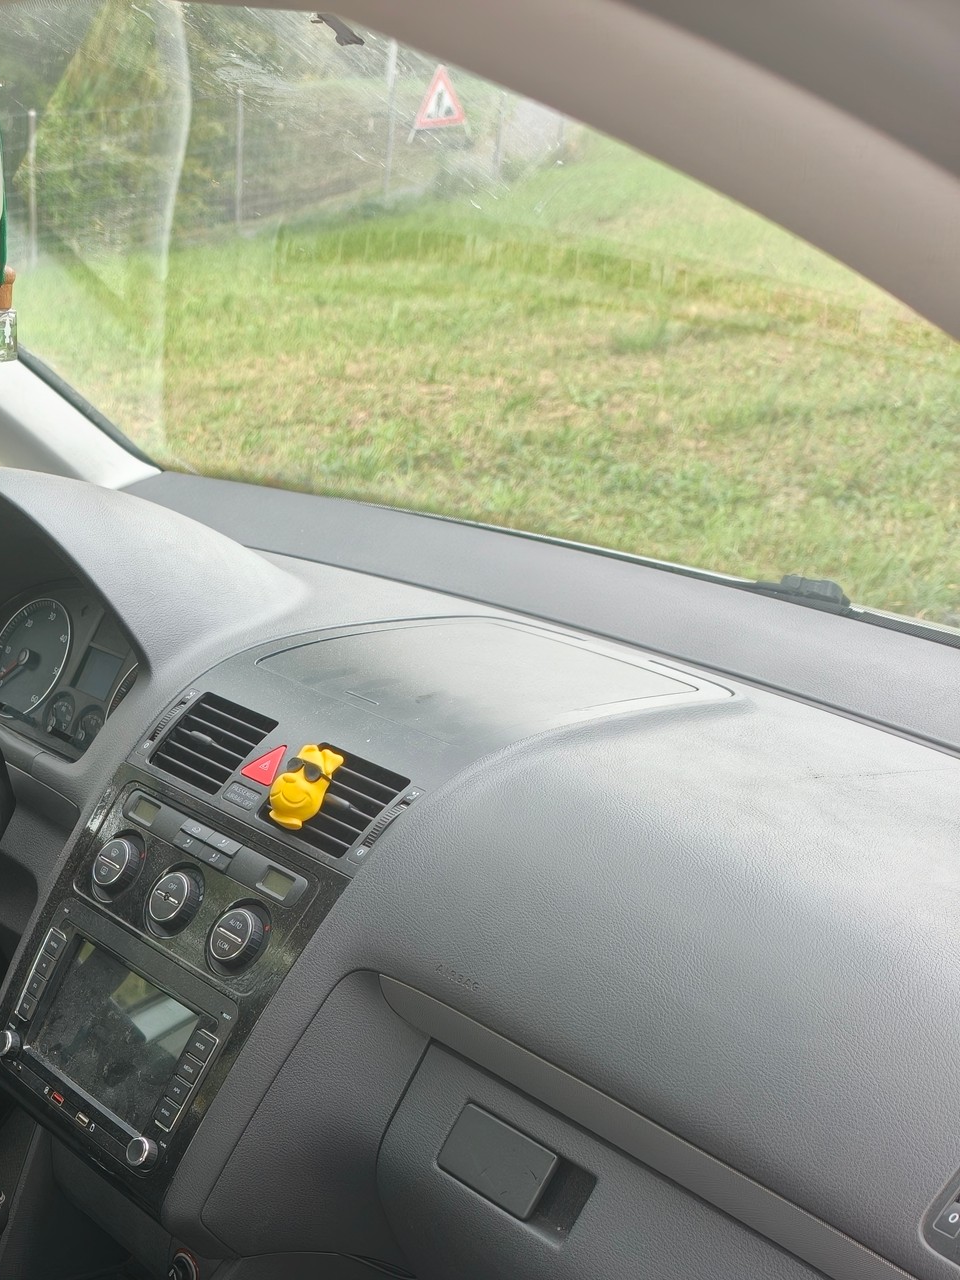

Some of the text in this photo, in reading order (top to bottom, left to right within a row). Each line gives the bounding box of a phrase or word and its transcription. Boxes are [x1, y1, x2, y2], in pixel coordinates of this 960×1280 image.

[47, 611, 57, 621] 30
[59, 634, 68, 643] 40
[30, 694, 39, 703] 60
[231, 785, 260, 801] PASSENGER
[226, 791, 254, 807] AIRBAG OFF
[168, 882, 178, 891] OFF
[229, 919, 243, 930] AUTO
[216, 939, 230, 951] ECON
[434, 964, 480, 993] AIRBAG
[195, 1041, 206, 1051] MODE
[183, 1064, 194, 1074] MEDIA
[948, 1213, 960, 1224] 0
